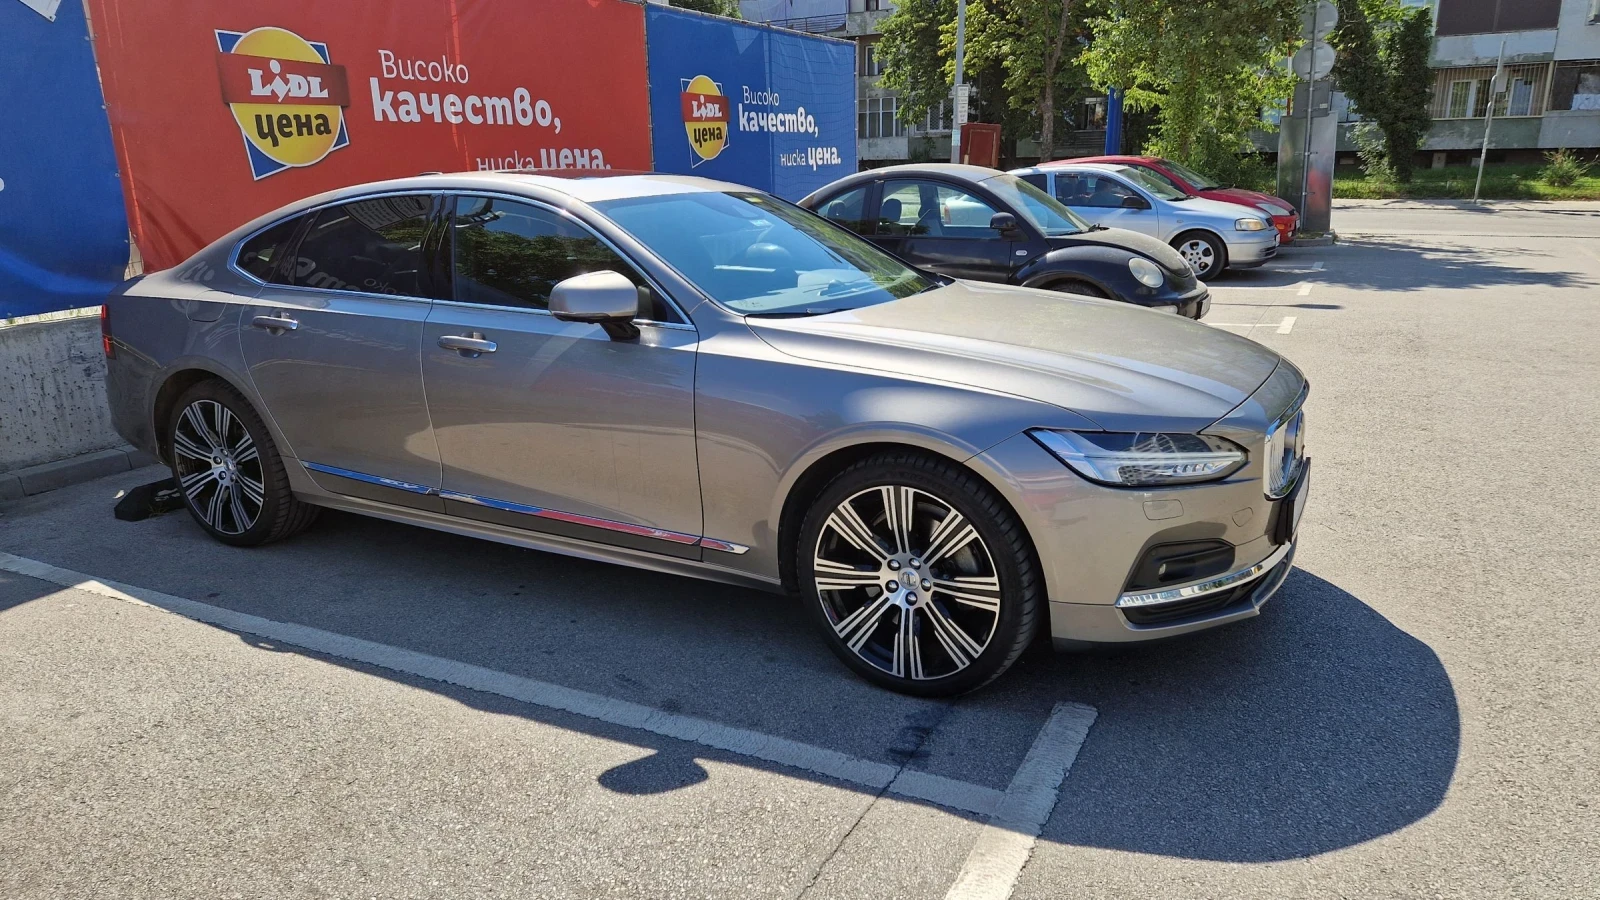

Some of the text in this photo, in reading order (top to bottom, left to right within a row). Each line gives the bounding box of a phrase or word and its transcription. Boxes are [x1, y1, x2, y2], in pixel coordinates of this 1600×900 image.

[378, 49, 469, 84] Високо
[369, 77, 561, 134] качество,
[742, 85, 780, 106] Високо
[254, 113, 332, 148] цена
[693, 126, 723, 148] цена
[738, 103, 819, 138] качество,
[780, 146, 842, 171] ниска цена.
